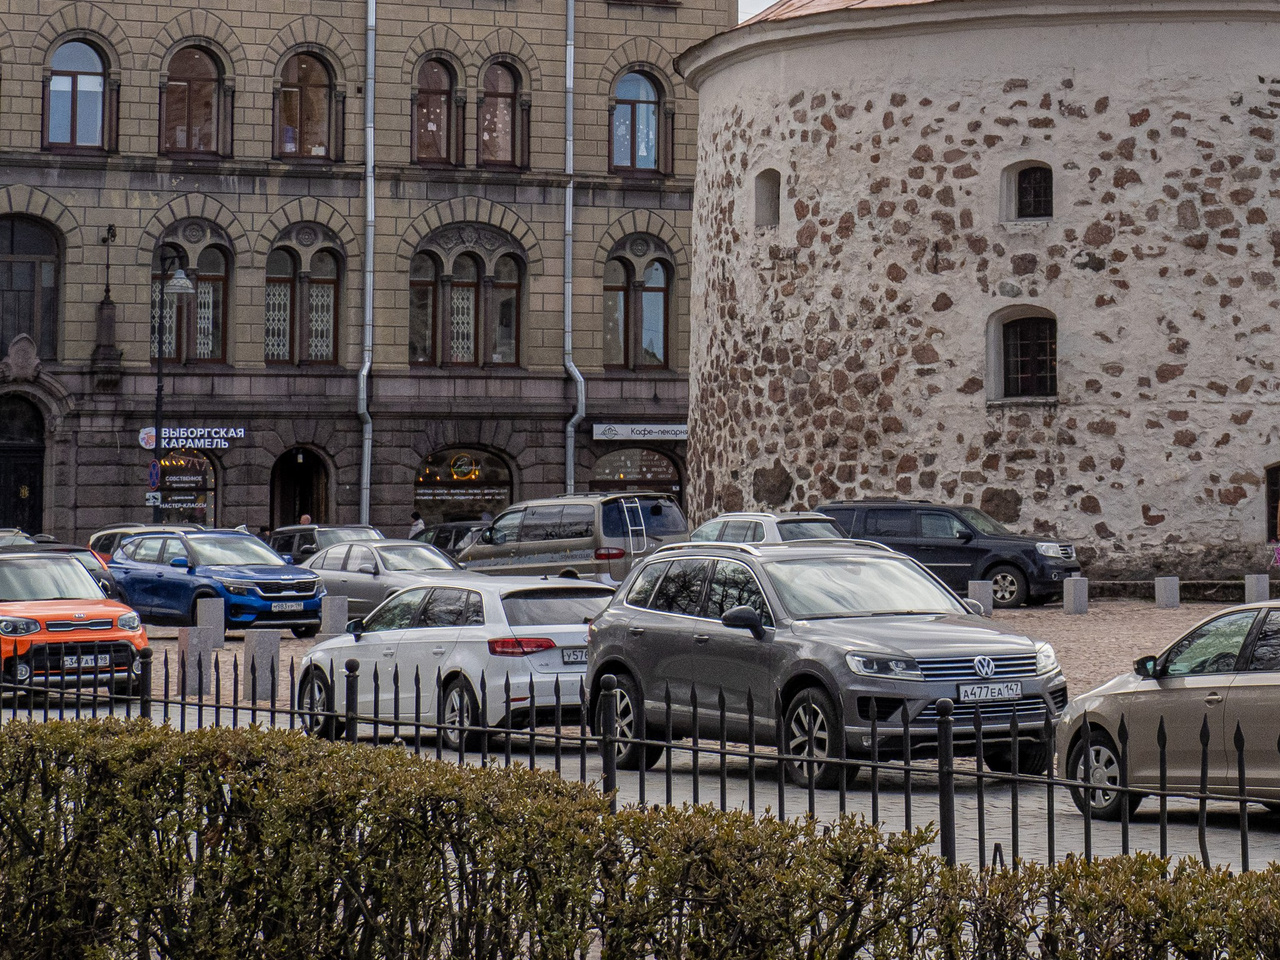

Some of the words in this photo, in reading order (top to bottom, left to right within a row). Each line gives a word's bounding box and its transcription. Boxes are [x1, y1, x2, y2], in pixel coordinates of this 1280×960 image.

[161, 428, 245, 438] ВЫБОРГСКАЯ
[161, 439, 229, 448] КАРАМЕЛЬ
[1004, 683, 1019, 694] 147
